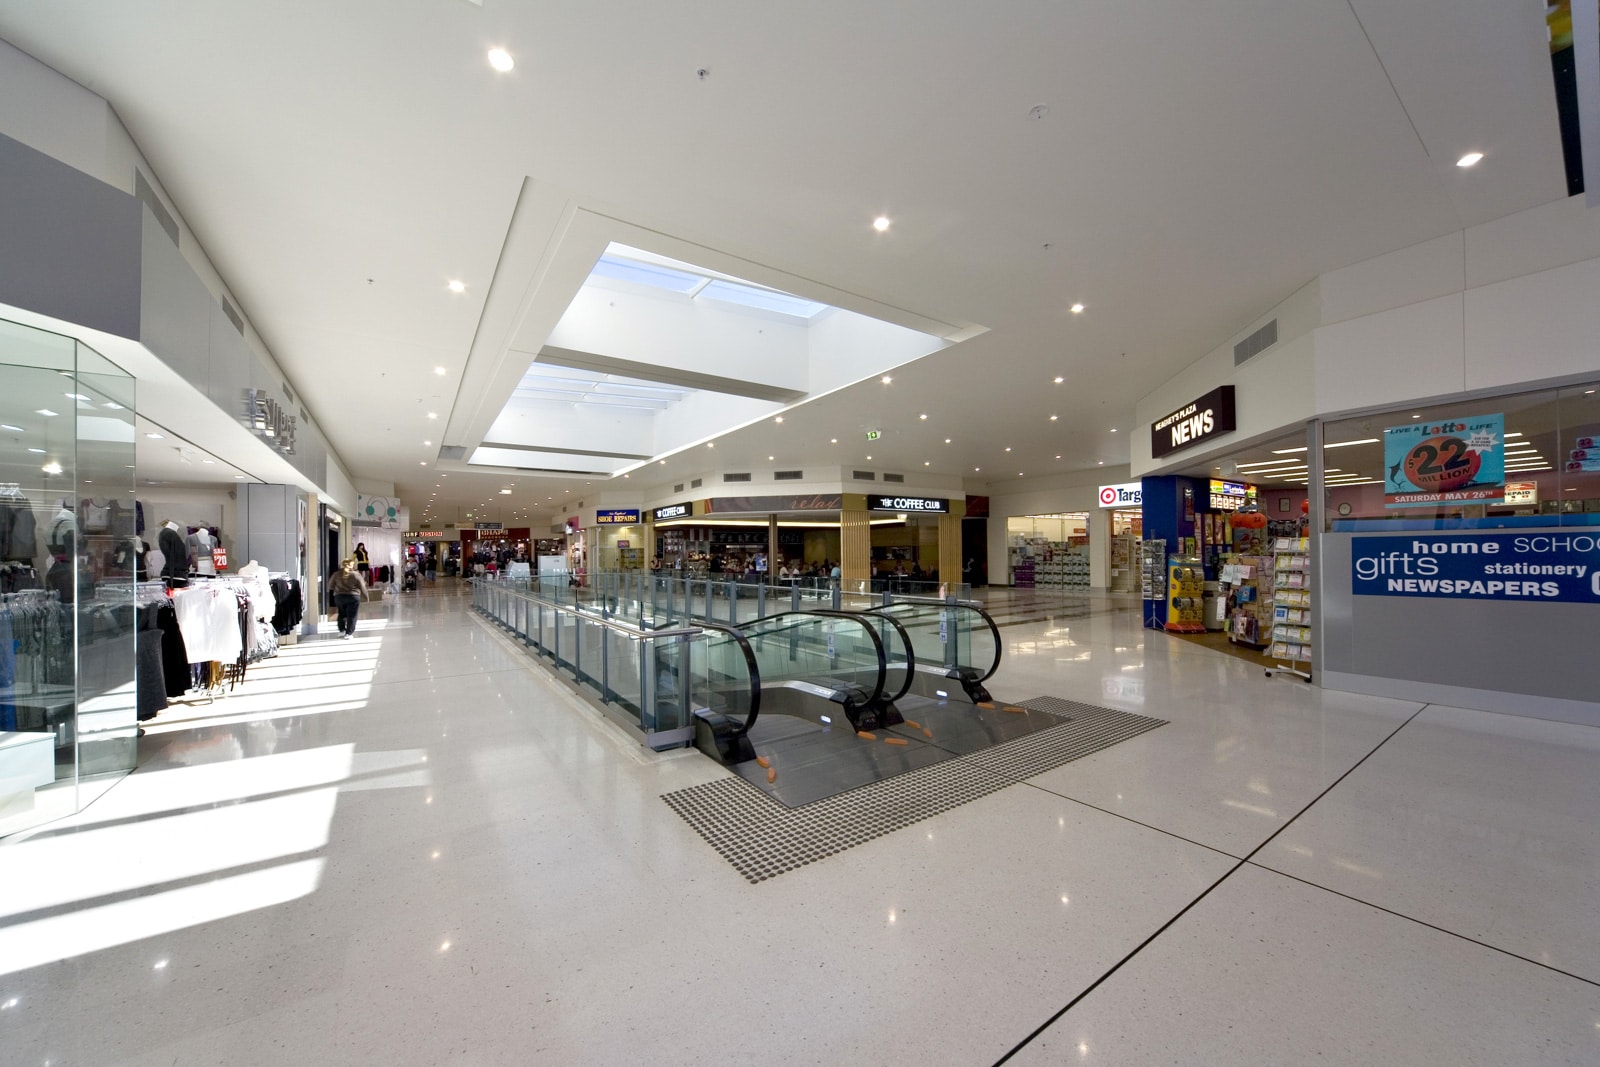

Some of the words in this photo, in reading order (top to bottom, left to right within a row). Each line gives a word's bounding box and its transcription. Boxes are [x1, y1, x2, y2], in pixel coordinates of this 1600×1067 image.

[1180, 403, 1197, 419] PLAZA
[1171, 408, 1214, 447] NEWS
[1390, 427, 1411, 435] LIVE
[1421, 422, 1467, 437] Lotto
[1418, 467, 1470, 482] MILLION
[790, 494, 841, 510] relax
[1117, 488, 1142, 503] Targ
[1394, 494, 1442, 503] SATURDAY
[1444, 492, 1469, 500] MAY
[1472, 490, 1494, 499] 26TH
[880, 498, 894, 507] THE
[894, 498, 924, 509] COFFEE
[925, 500, 941, 509] CLUB
[598, 515, 612, 523] SHOE
[614, 514, 637, 523] REPAIRS
[662, 506, 677, 517] COFFEE
[1412, 540, 1500, 555] home
[1514, 536, 1600, 553] SCHO
[1355, 552, 1439, 581] gifts
[1484, 562, 1587, 578] stationery
[1387, 578, 1560, 597] NEWSPAPERS
